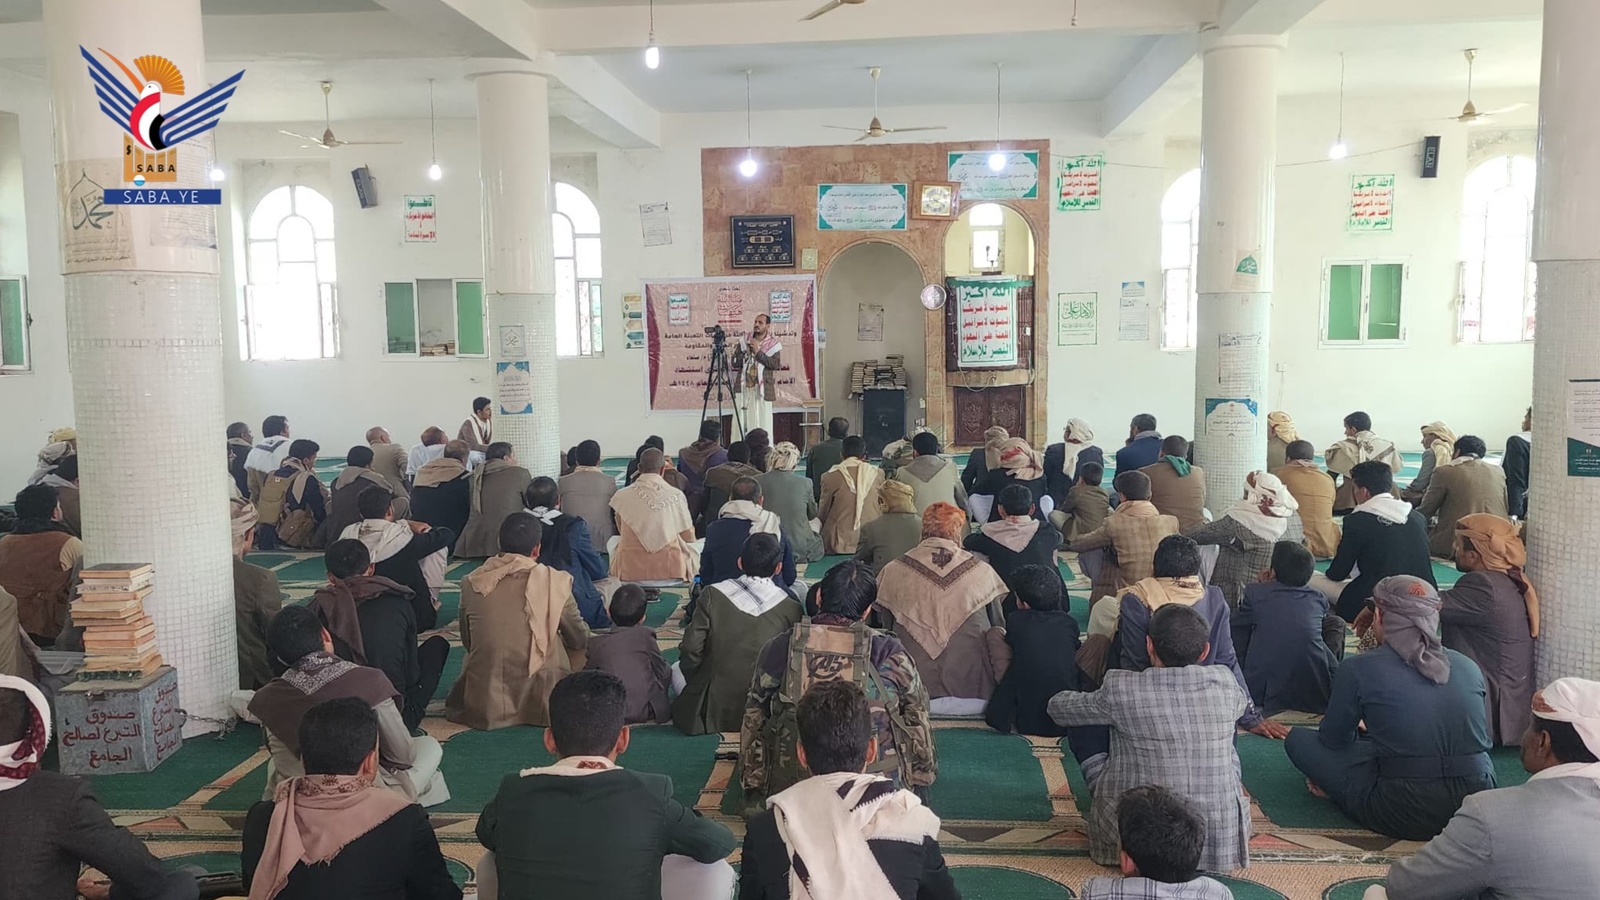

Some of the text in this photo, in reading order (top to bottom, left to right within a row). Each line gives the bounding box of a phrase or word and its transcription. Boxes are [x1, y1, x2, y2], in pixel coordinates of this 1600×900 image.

[992, 286, 1010, 297] الله
[990, 302, 1010, 314] الموت
[990, 316, 1010, 328] الموت
[982, 332, 992, 342] على
[990, 342, 1011, 358] النصر
[155, 682, 178, 704] صندوق
[86, 710, 135, 724] صندوق
[62, 724, 142, 746] التبرع لصالح
[88, 746, 132, 768] الجامع
